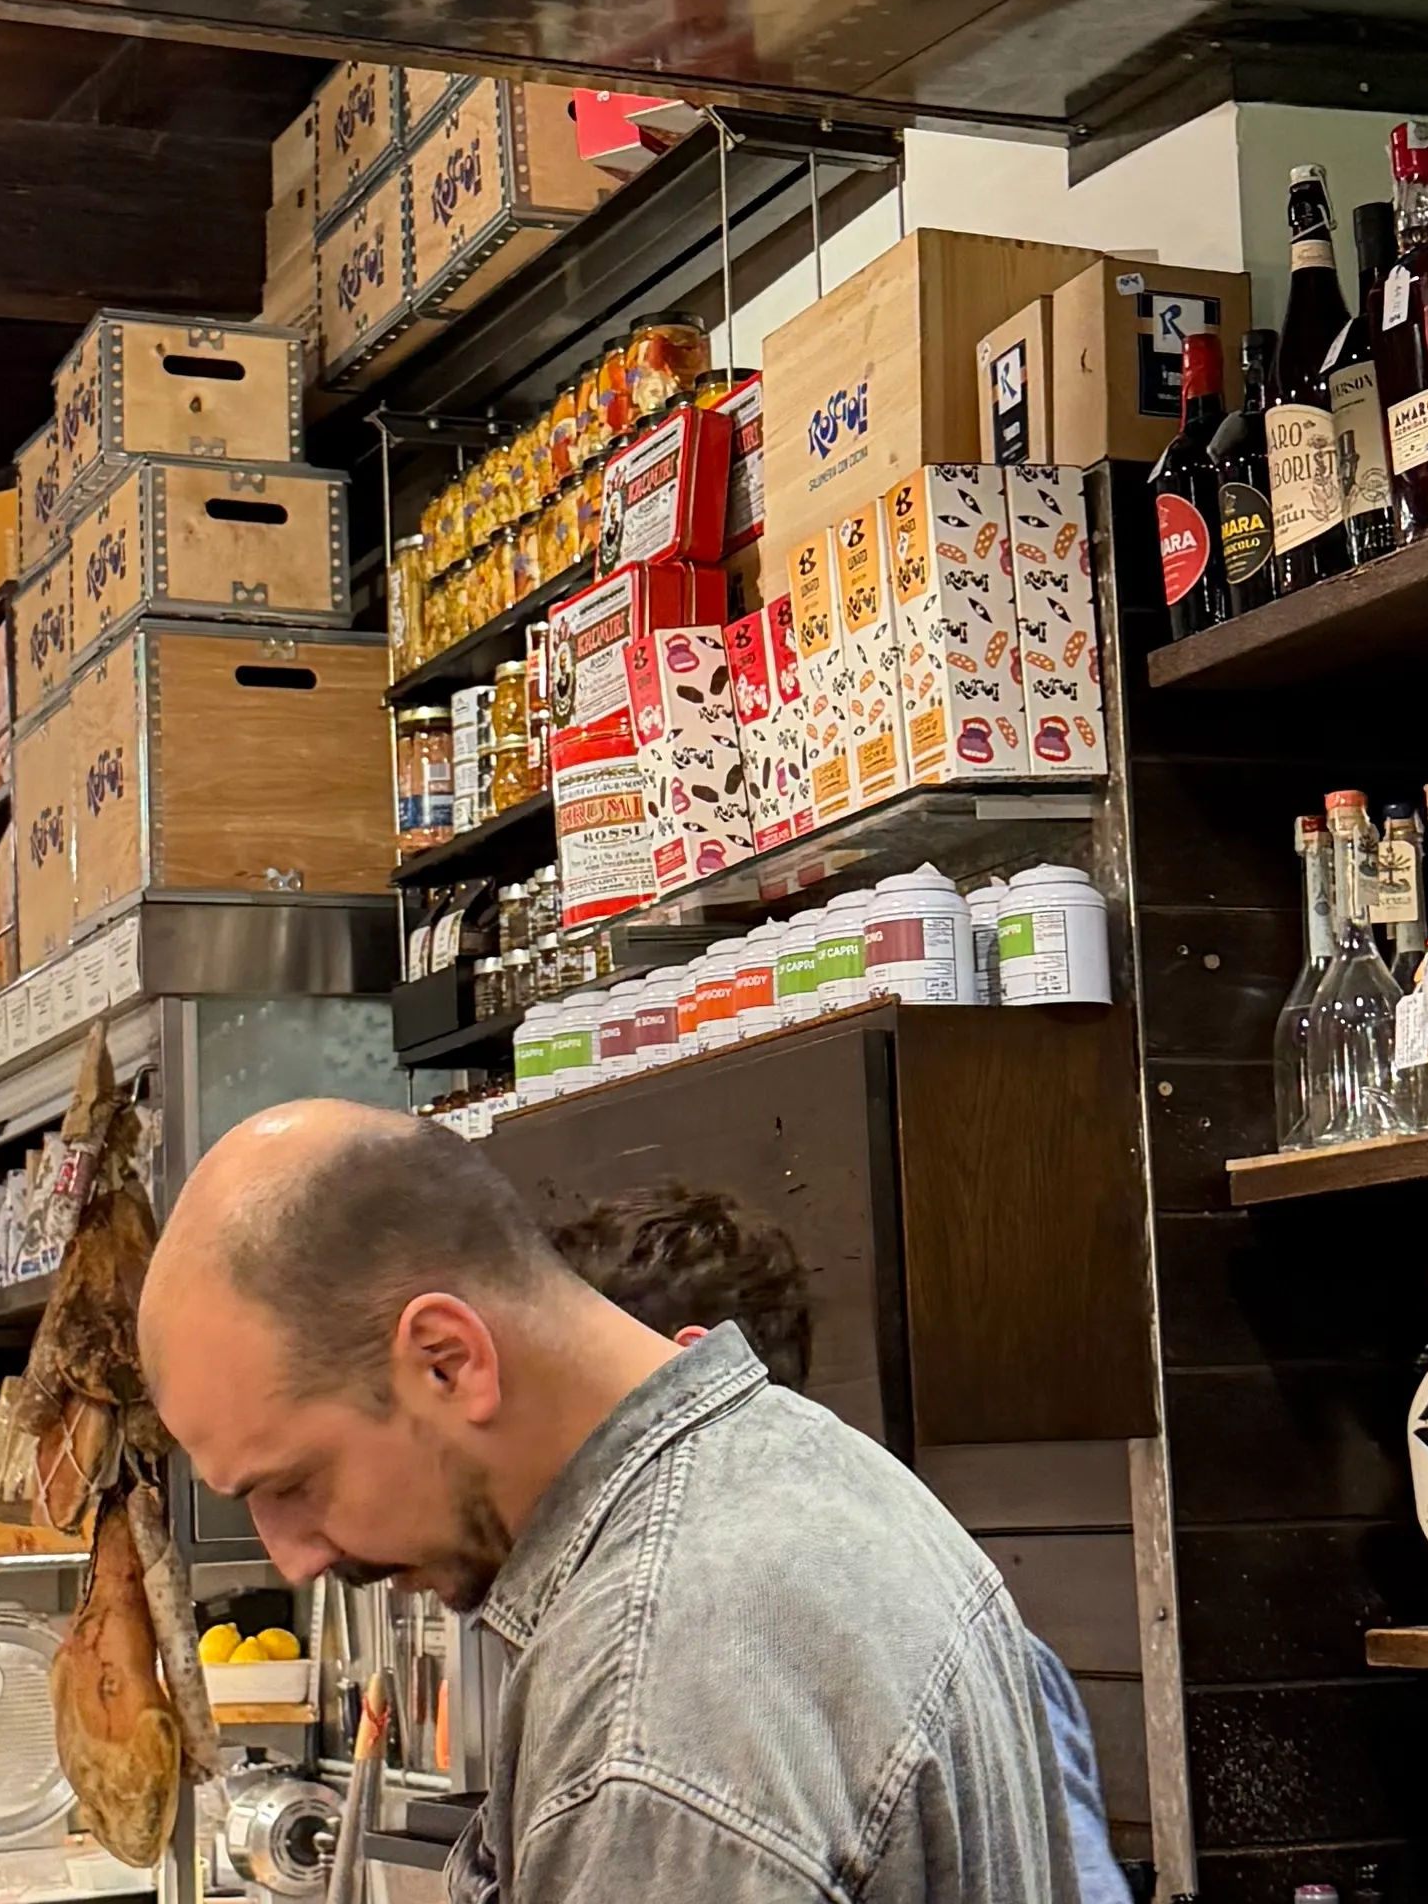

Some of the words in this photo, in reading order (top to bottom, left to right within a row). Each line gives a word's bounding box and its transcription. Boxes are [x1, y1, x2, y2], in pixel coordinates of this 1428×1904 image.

[1269, 420, 1304, 454] ARO
[1272, 450, 1337, 491] BORIST
[559, 792, 644, 831] KRUMI
[582, 826, 641, 844] ROSSI
[827, 943, 859, 959] CAPRI
